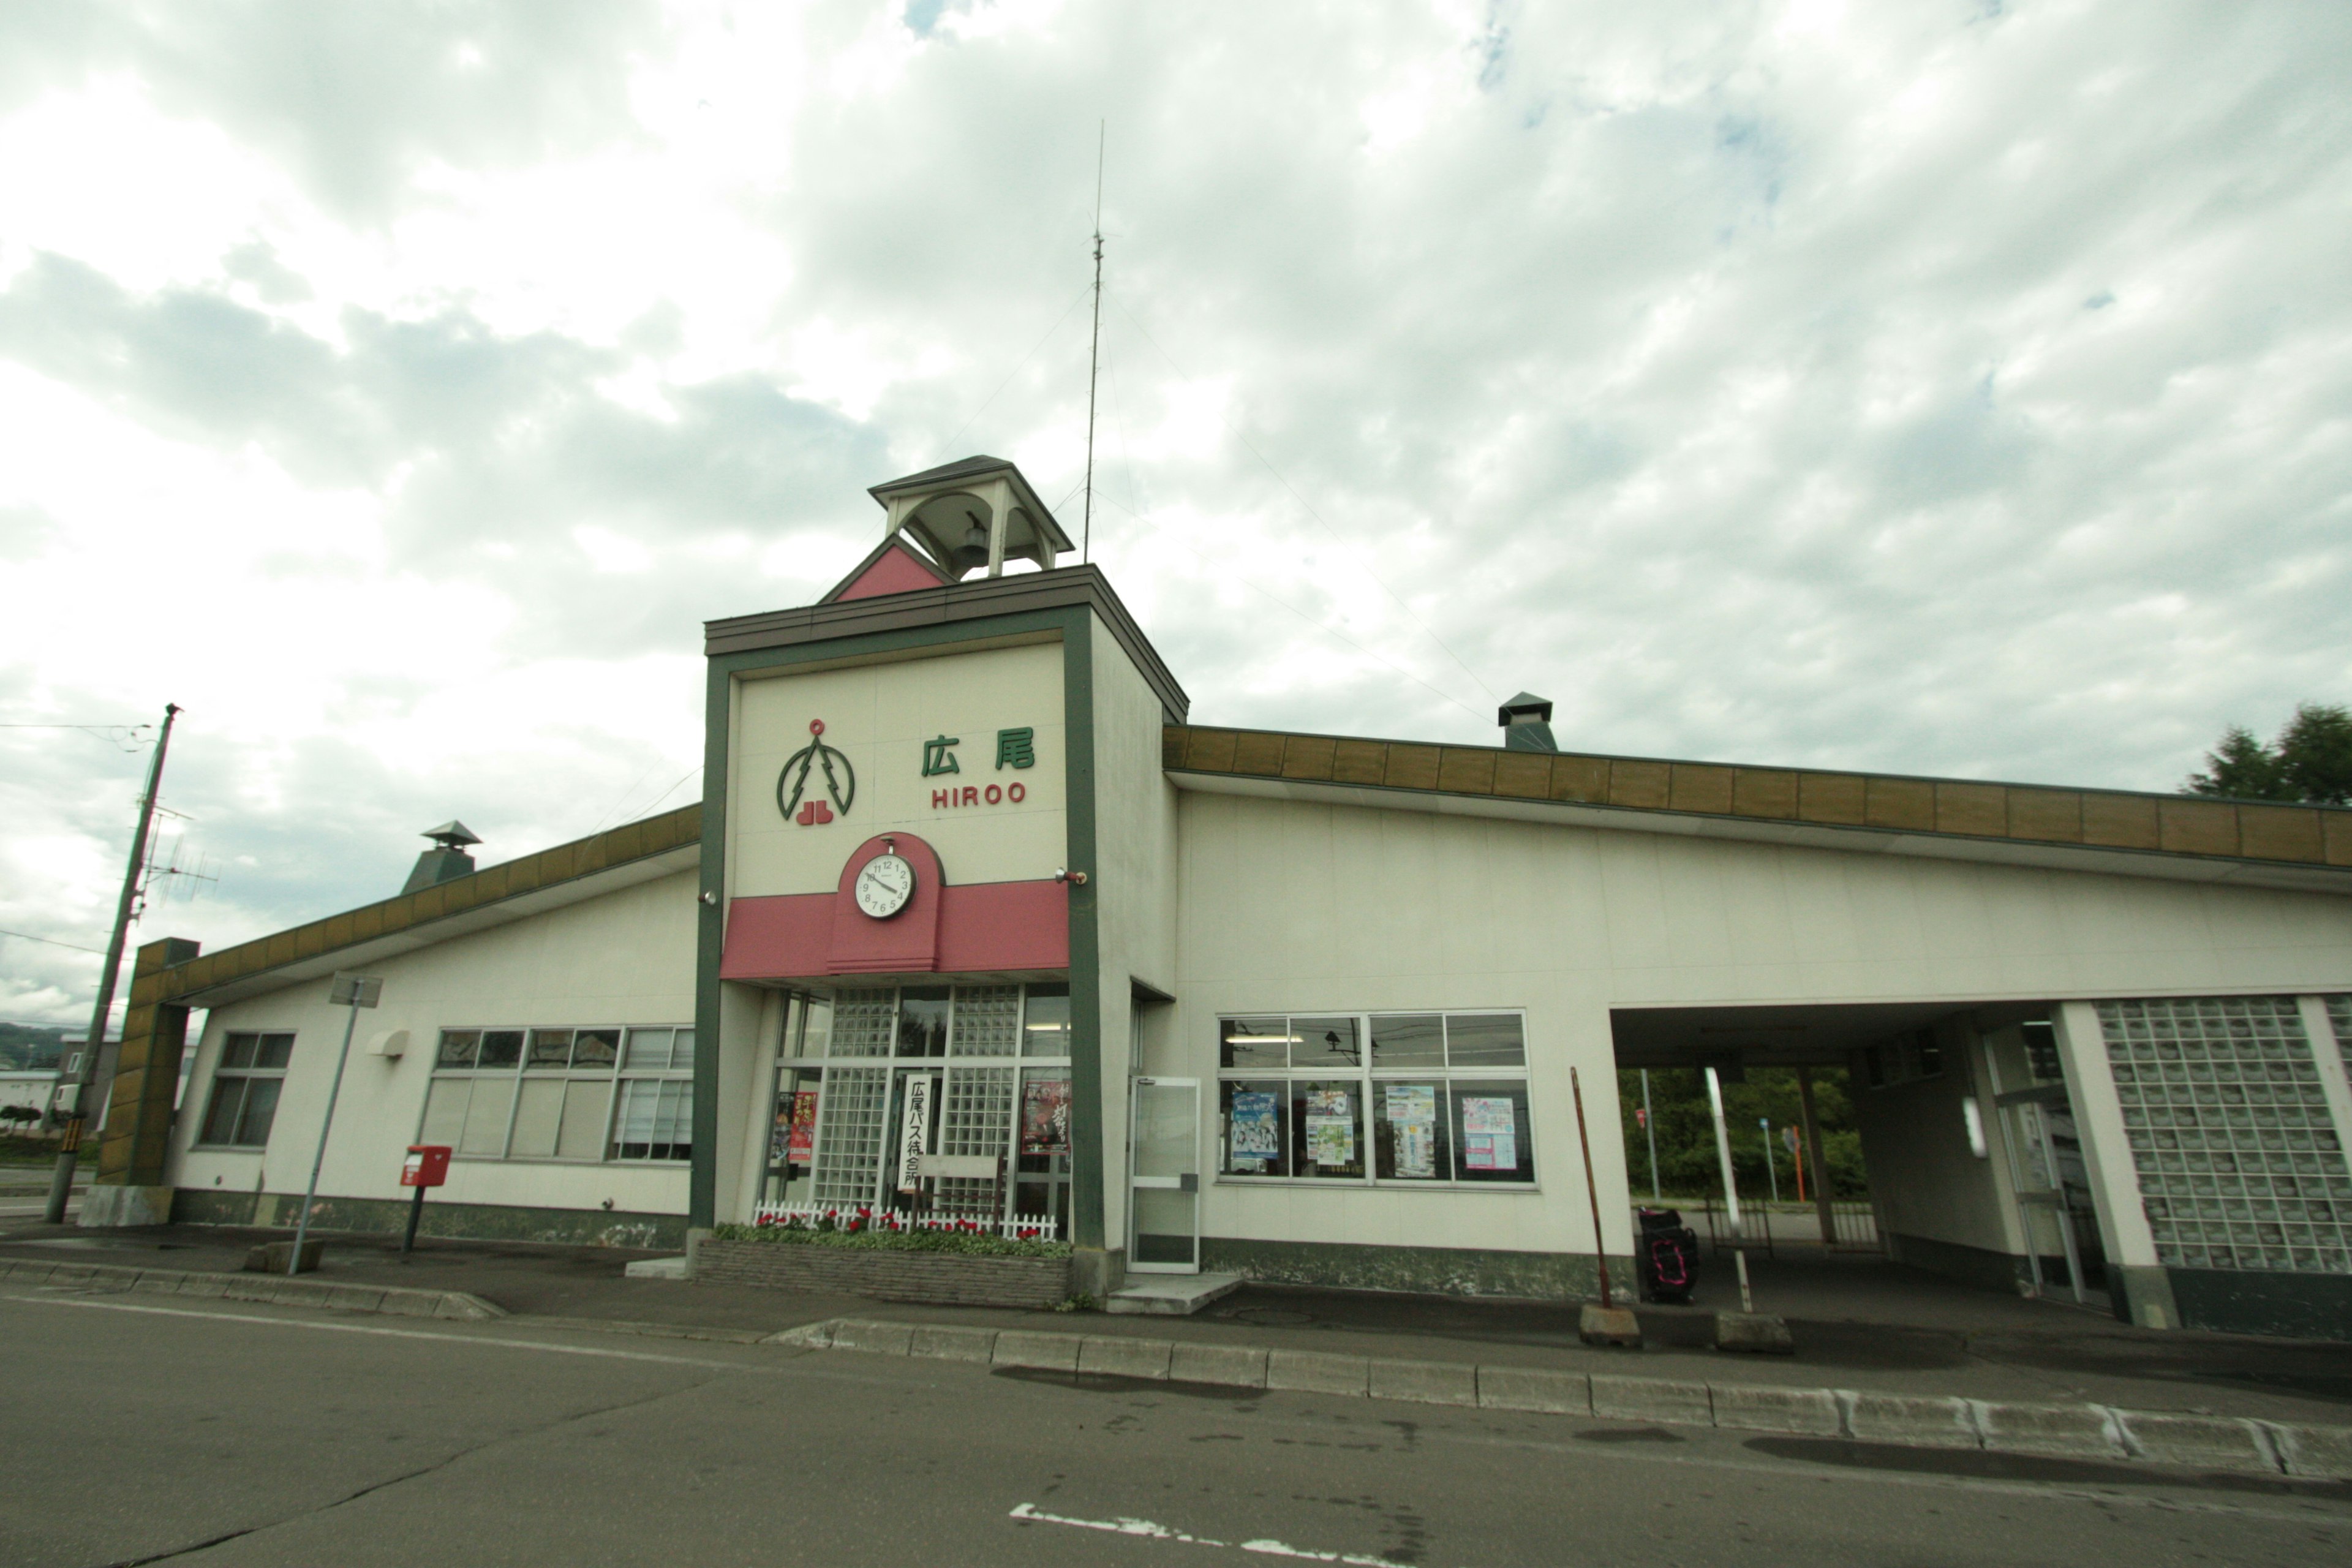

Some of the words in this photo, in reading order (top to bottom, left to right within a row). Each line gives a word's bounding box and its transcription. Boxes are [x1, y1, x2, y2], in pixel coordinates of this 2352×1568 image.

[921, 726, 1035, 777] 広尾
[932, 782, 1026, 809] HIROO
[873, 864, 881, 873] 11
[883, 861, 892, 869] 12
[895, 864, 899, 872] 1
[900, 870, 906, 879] 2
[863, 883, 869, 892] 9
[902, 881, 908, 890] 3
[865, 894, 871, 903] 8
[872, 901, 878, 910] 7
[880, 903, 886, 912] 6
[889, 900, 896, 908] 5
[904, 1081, 925, 1186] 広尾バス待合所
